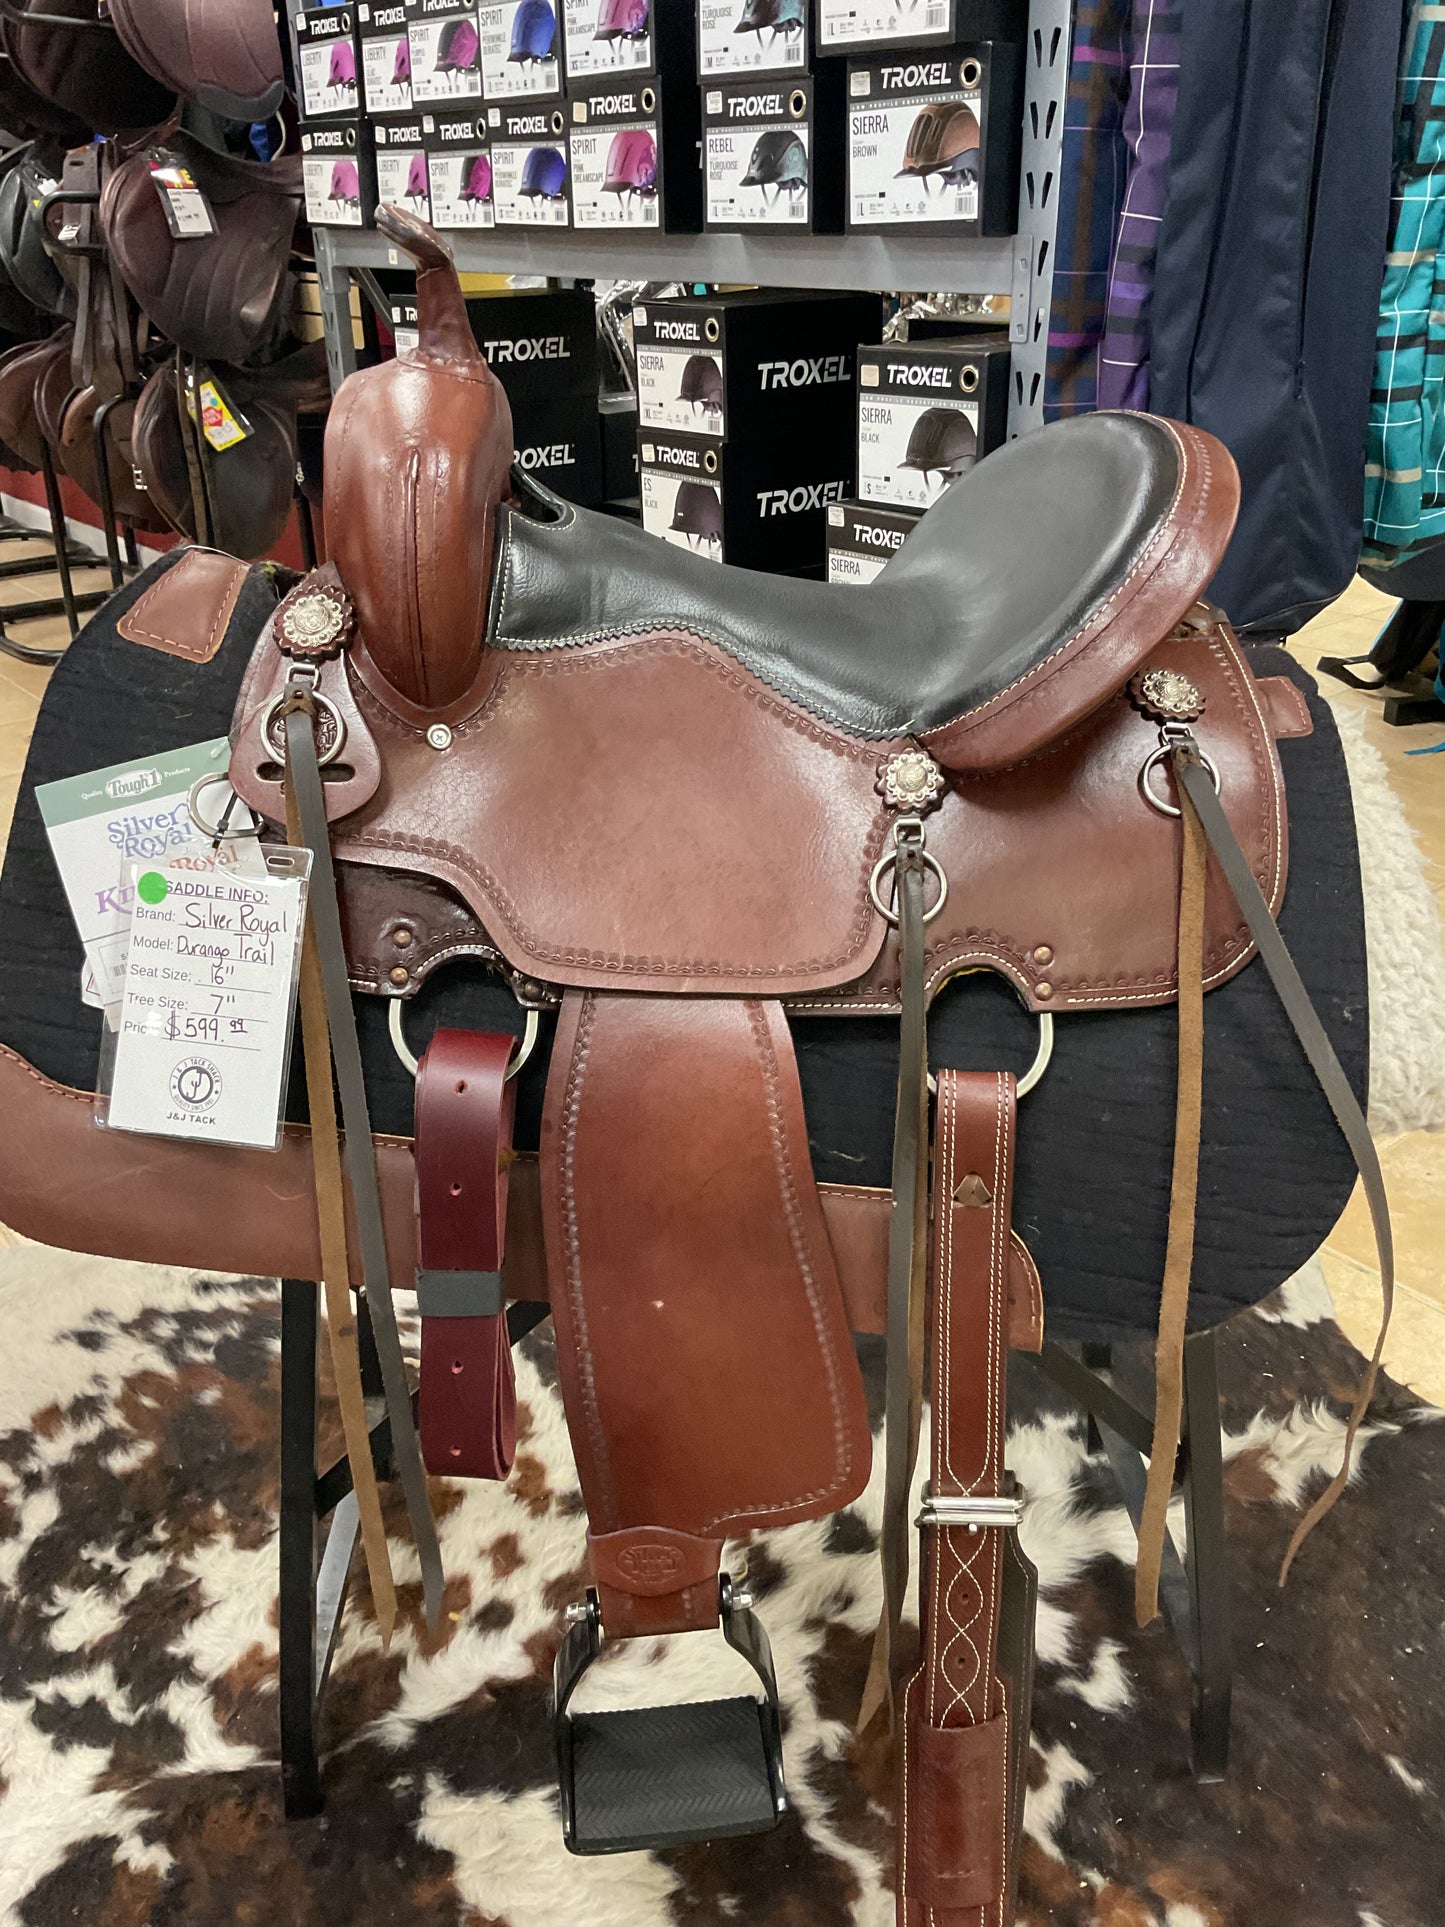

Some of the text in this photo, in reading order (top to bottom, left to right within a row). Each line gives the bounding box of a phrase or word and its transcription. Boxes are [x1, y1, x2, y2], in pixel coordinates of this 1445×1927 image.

[310, 17, 340, 35] TROXEL
[373, 7, 406, 26] TROXEL
[481, 9, 503, 27] SPIRIT
[410, 28, 429, 42] SPIRIT
[881, 62, 952, 89] TROXEL
[589, 94, 637, 115] TROXEL
[727, 95, 784, 117] TROXEL
[388, 126, 422, 143] TROXEL
[440, 122, 475, 140] TROXEL
[507, 116, 548, 135] TROXEL
[852, 114, 889, 136] SIERRA
[313, 132, 344, 147] TROXEL
[572, 138, 597, 156] SPIRIT
[709, 138, 734, 154] REBEL
[493, 151, 514, 165] SPIRIT
[853, 145, 878, 158] BROWN
[431, 162, 449, 177] SPIRIT
[654, 321, 700, 341] TROXEL
[484, 337, 570, 363] TROXEL
[640, 355, 664, 371] SIERRA
[758, 355, 851, 390] TROXEL
[887, 364, 952, 388] TROXEL
[861, 407, 892, 425] SIERRA
[861, 432, 880, 444] BLACK
[513, 444, 576, 470] OXEL
[656, 445, 700, 469] TROXEL
[644, 477, 652, 492] ES
[757, 480, 850, 518] TROXEL
[831, 558, 861, 576] SIERRA
[164, 767, 191, 778] Products
[107, 802, 188, 845] Silver
[118, 822, 192, 859] Royal
[166, 880, 269, 903] SADDLE INFO:
[136, 903, 287, 947] Brand: Silver Royal
[133, 933, 275, 968] Model: Durango Trail
[130, 963, 158, 979] Seat
[162, 967, 191, 982] Size:
[127, 992, 155, 1006] Tree
[158, 996, 188, 1011] Size:
[190, 1058, 206, 1066] TACK
[206, 1063, 220, 1084] SHACK
[167, 1112, 216, 1125] J&J TACK
